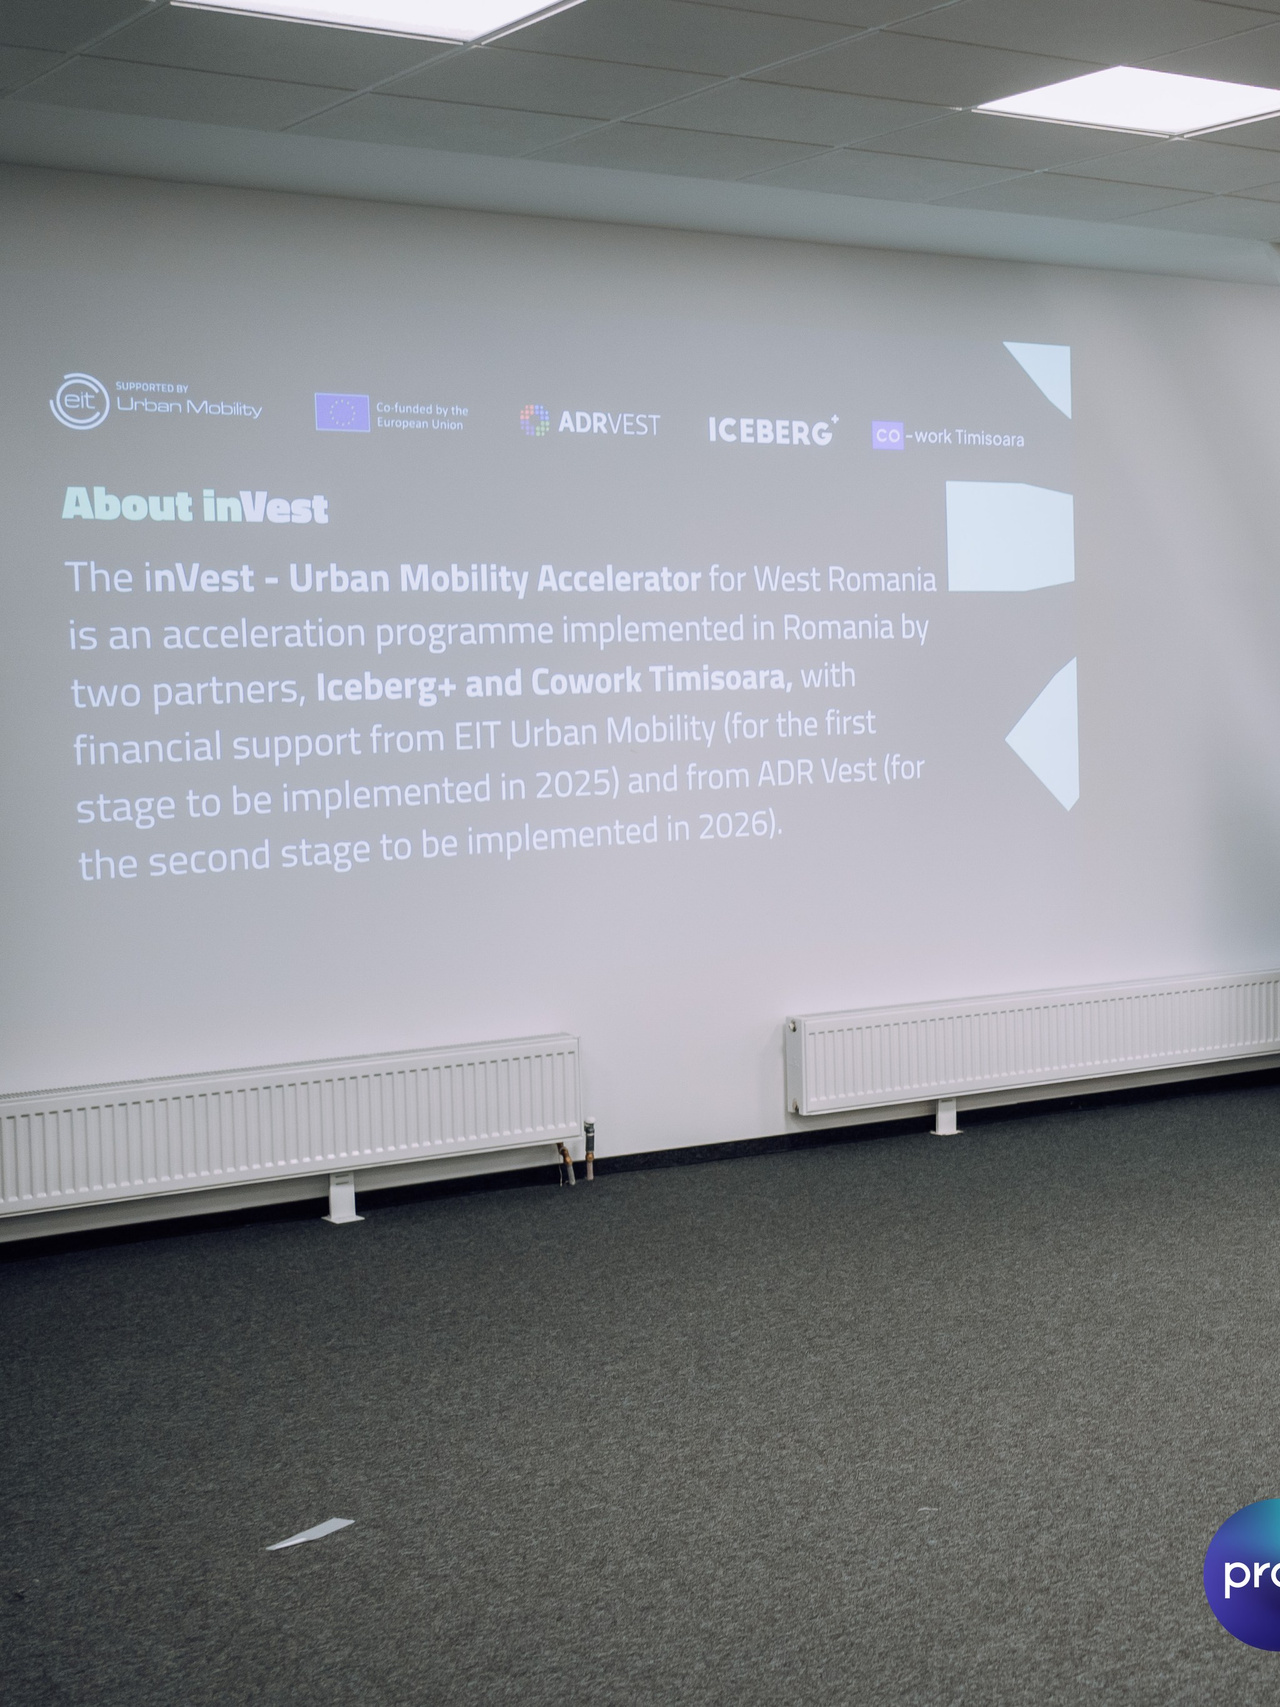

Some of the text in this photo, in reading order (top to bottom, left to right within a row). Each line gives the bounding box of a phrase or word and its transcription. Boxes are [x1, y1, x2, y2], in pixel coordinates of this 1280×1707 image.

[65, 392, 262, 419] eit Urban Mobility
[116, 381, 188, 393] SUPPORTED BY
[377, 402, 468, 417] Co-funded by the
[378, 417, 463, 430] European Union
[559, 411, 660, 435] ADRVEST
[955, 429, 1024, 447] Timisoara
[62, 487, 328, 524] About inVest
[65, 561, 132, 592] The
[146, 562, 254, 592] inVest
[290, 563, 389, 592] Urban
[401, 564, 528, 599] Mobility
[538, 565, 701, 592] Accelerator
[709, 564, 746, 592] for
[754, 566, 821, 592] West
[829, 566, 937, 592] Romania
[70, 613, 928, 654] is an acceleration programme implemented in Romania by
[71, 661, 855, 714] two partners, Iceberg+ and Cowork Timisoara, with
[73, 709, 876, 766] financial support from EIT Urban Mobility (for the first
[77, 754, 925, 829] stage to be implemented in 2025) and from ADR Vest (for
[79, 808, 782, 880] the second stage to be implemented in 2026).
